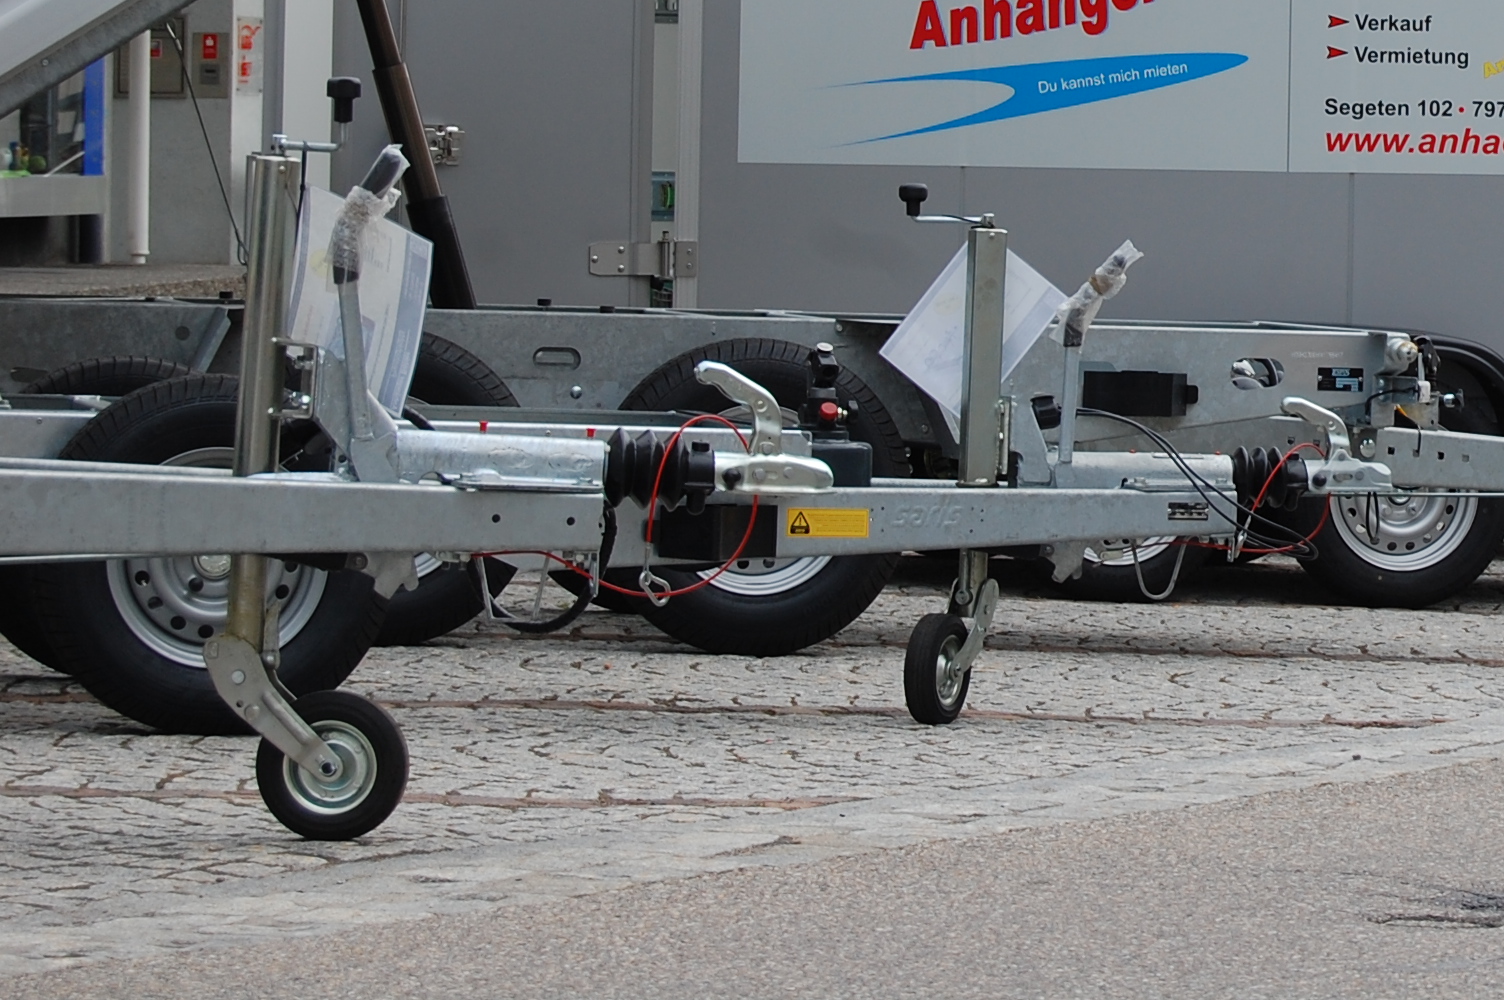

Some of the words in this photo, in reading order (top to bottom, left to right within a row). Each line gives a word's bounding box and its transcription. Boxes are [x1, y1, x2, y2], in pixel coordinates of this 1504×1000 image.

[1355, 14, 1432, 32] Verkauf
[1355, 47, 1469, 68] Vermietung
[1038, 80, 1058, 94] Du
[1061, 73, 1105, 91] kannst
[1109, 67, 1140, 85] mich
[1144, 62, 1188, 79] mieten
[1325, 98, 1409, 120] Segeten
[1418, 100, 1453, 117] 102
